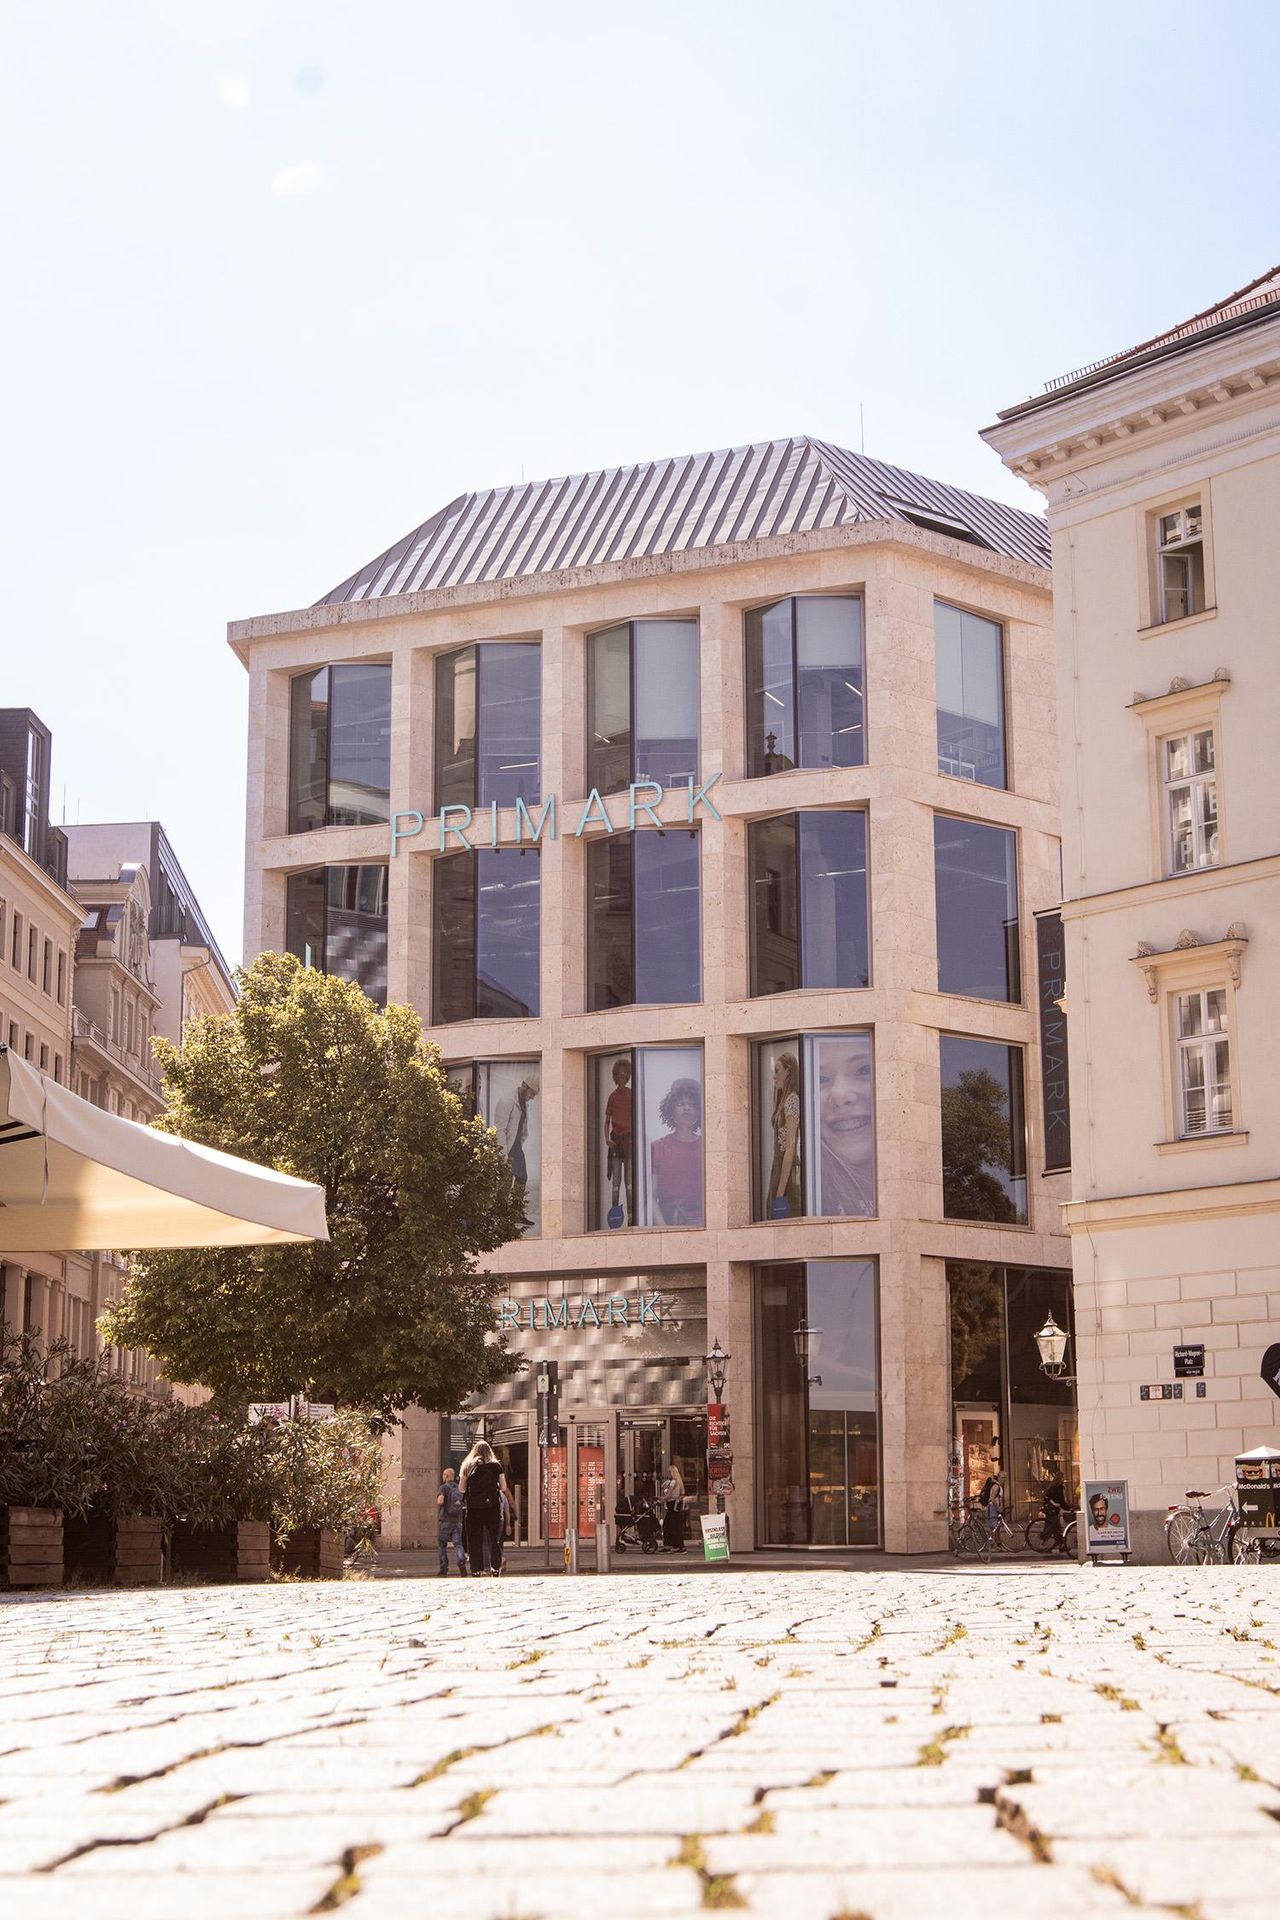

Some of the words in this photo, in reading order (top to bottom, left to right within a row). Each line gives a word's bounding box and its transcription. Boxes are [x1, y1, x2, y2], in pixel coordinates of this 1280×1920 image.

[390, 772, 722, 858] PRIMARK
[1042, 951, 1067, 1131] PRIMARK
[499, 1294, 661, 1329] RIMARK
